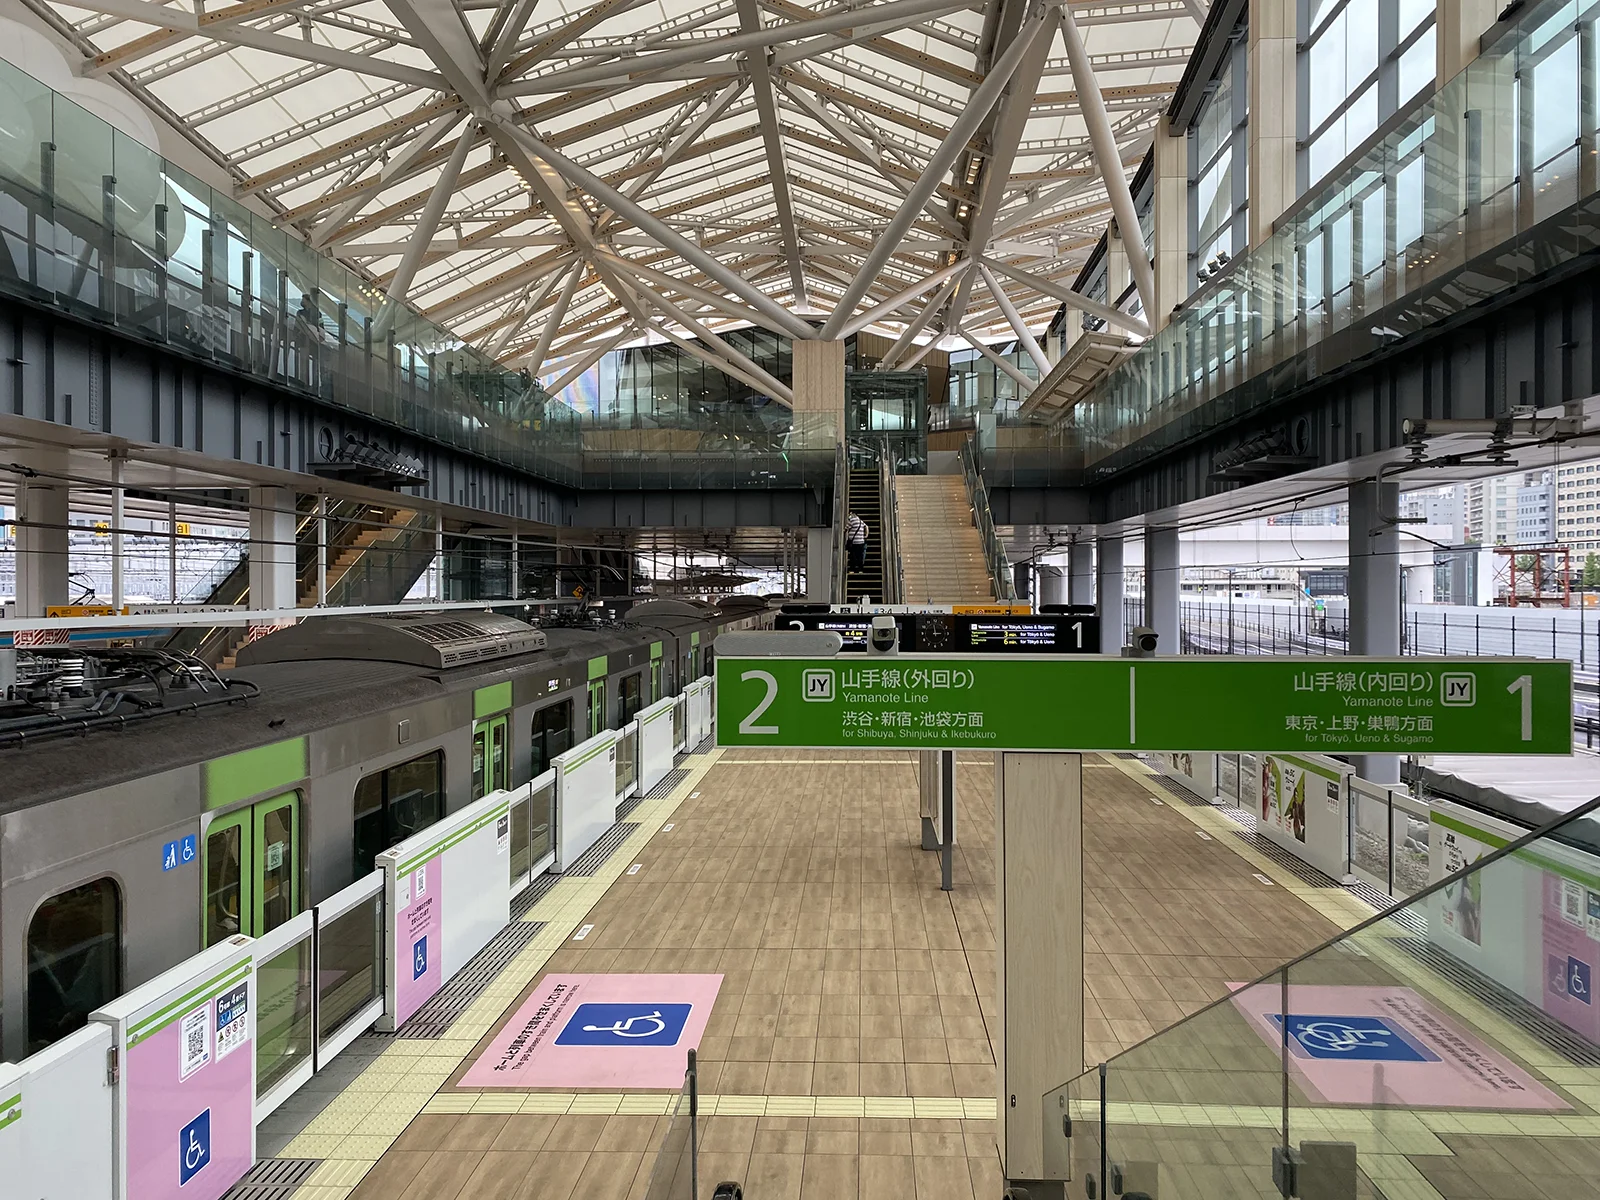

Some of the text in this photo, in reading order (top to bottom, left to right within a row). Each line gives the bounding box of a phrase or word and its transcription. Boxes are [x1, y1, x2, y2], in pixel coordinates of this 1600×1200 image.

[1072, 622, 1083, 648] 1
[810, 678, 828, 692] JY
[842, 668, 974, 689] 山手線(外回り)
[1294, 672, 1433, 692] 山手線(内回り)
[1448, 682, 1468, 696] JY
[738, 670, 779, 735] 2
[842, 692, 929, 703] Yamanote Line
[1342, 696, 1433, 707] Yamanote Line
[1506, 675, 1532, 741] 1
[842, 711, 984, 728] 渋谷・新宿・池袋方面
[1285, 715, 1433, 731] 東京・上野・巣鴨方面
[842, 729, 997, 740] for Shibuya, Shinjuku & Ikebukuro
[1305, 732, 1434, 746] for Tōkyō, Ueno & Sugamo
